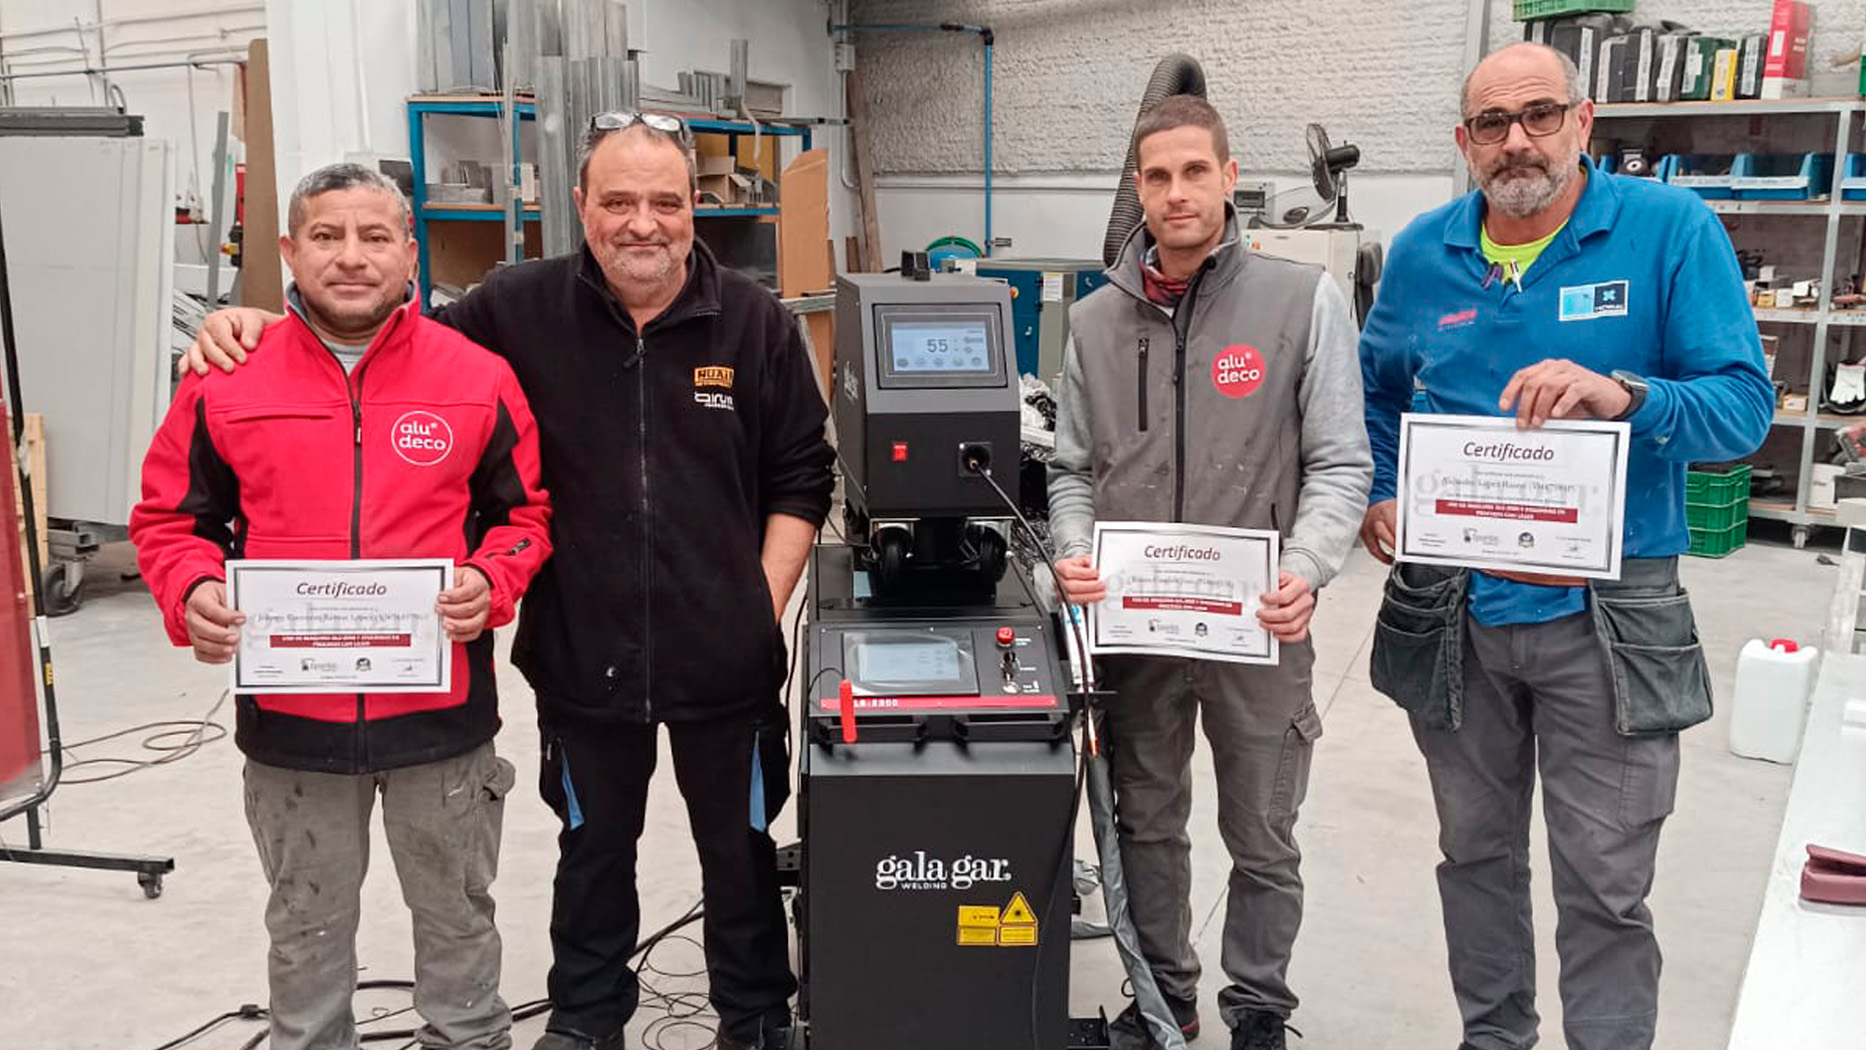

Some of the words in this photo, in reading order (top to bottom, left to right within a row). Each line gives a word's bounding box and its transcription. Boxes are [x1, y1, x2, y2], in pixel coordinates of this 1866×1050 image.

[926, 339, 949, 353] 55
[1217, 369, 1260, 384] deco
[398, 434, 447, 451] deco
[1463, 441, 1554, 461] Certificado
[1143, 545, 1221, 561] Certificado
[296, 582, 387, 598] Certificado
[876, 851, 948, 890] gala
[901, 881, 948, 890] WELDING
